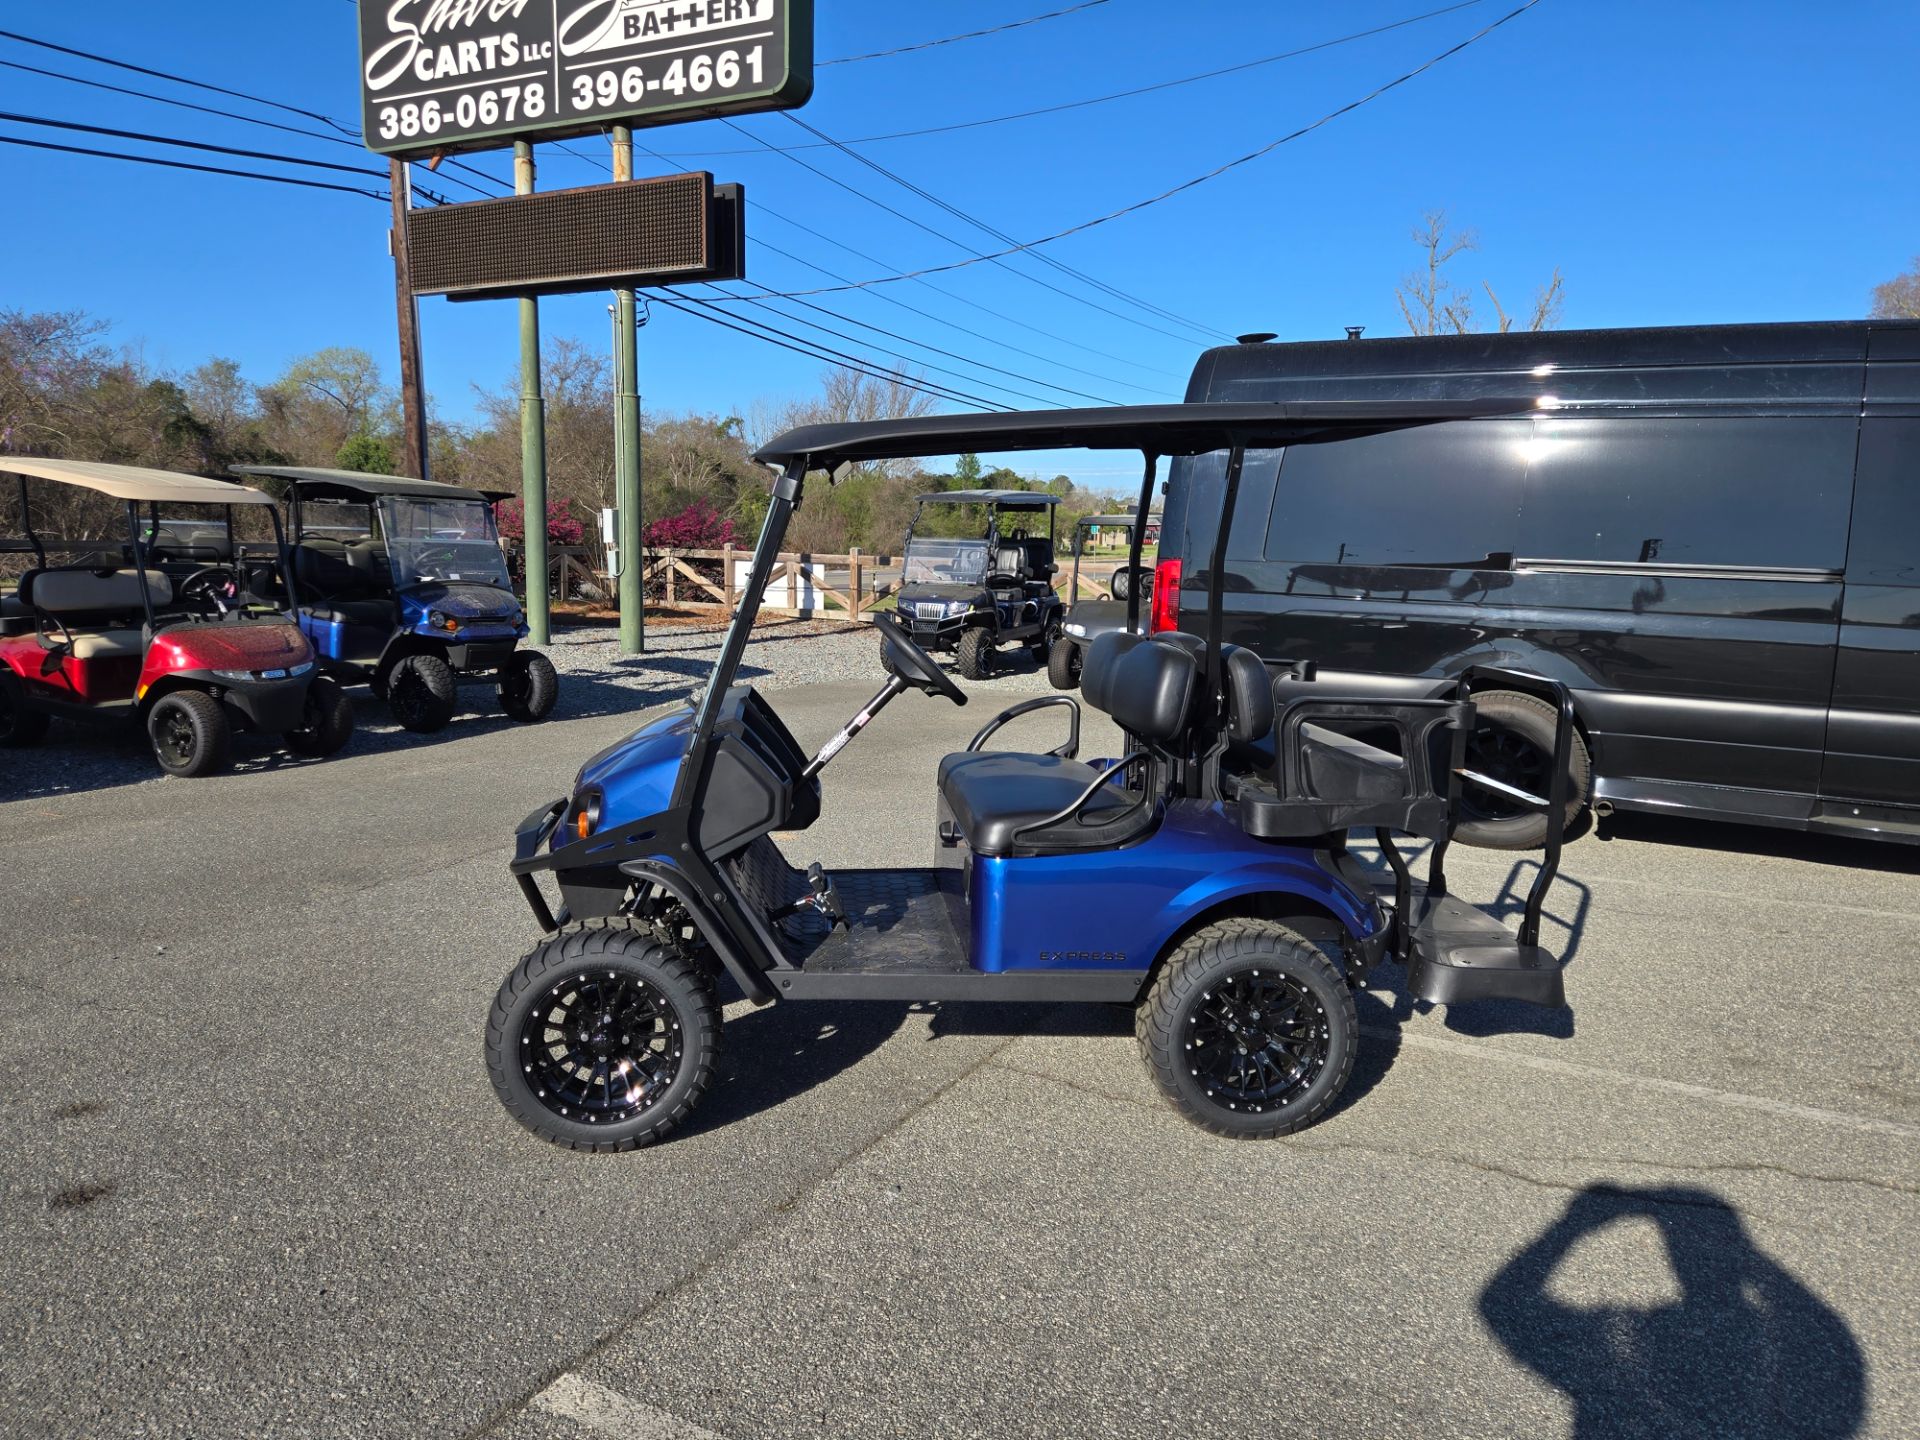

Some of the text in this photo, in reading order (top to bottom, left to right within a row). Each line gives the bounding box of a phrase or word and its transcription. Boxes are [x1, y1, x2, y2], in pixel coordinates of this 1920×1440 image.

[414, 33, 552, 82] CARTS LLC
[571, 46, 763, 110] 396-4661
[379, 83, 545, 140] 386-0678
[1040, 951, 1127, 961] EXPRESS
